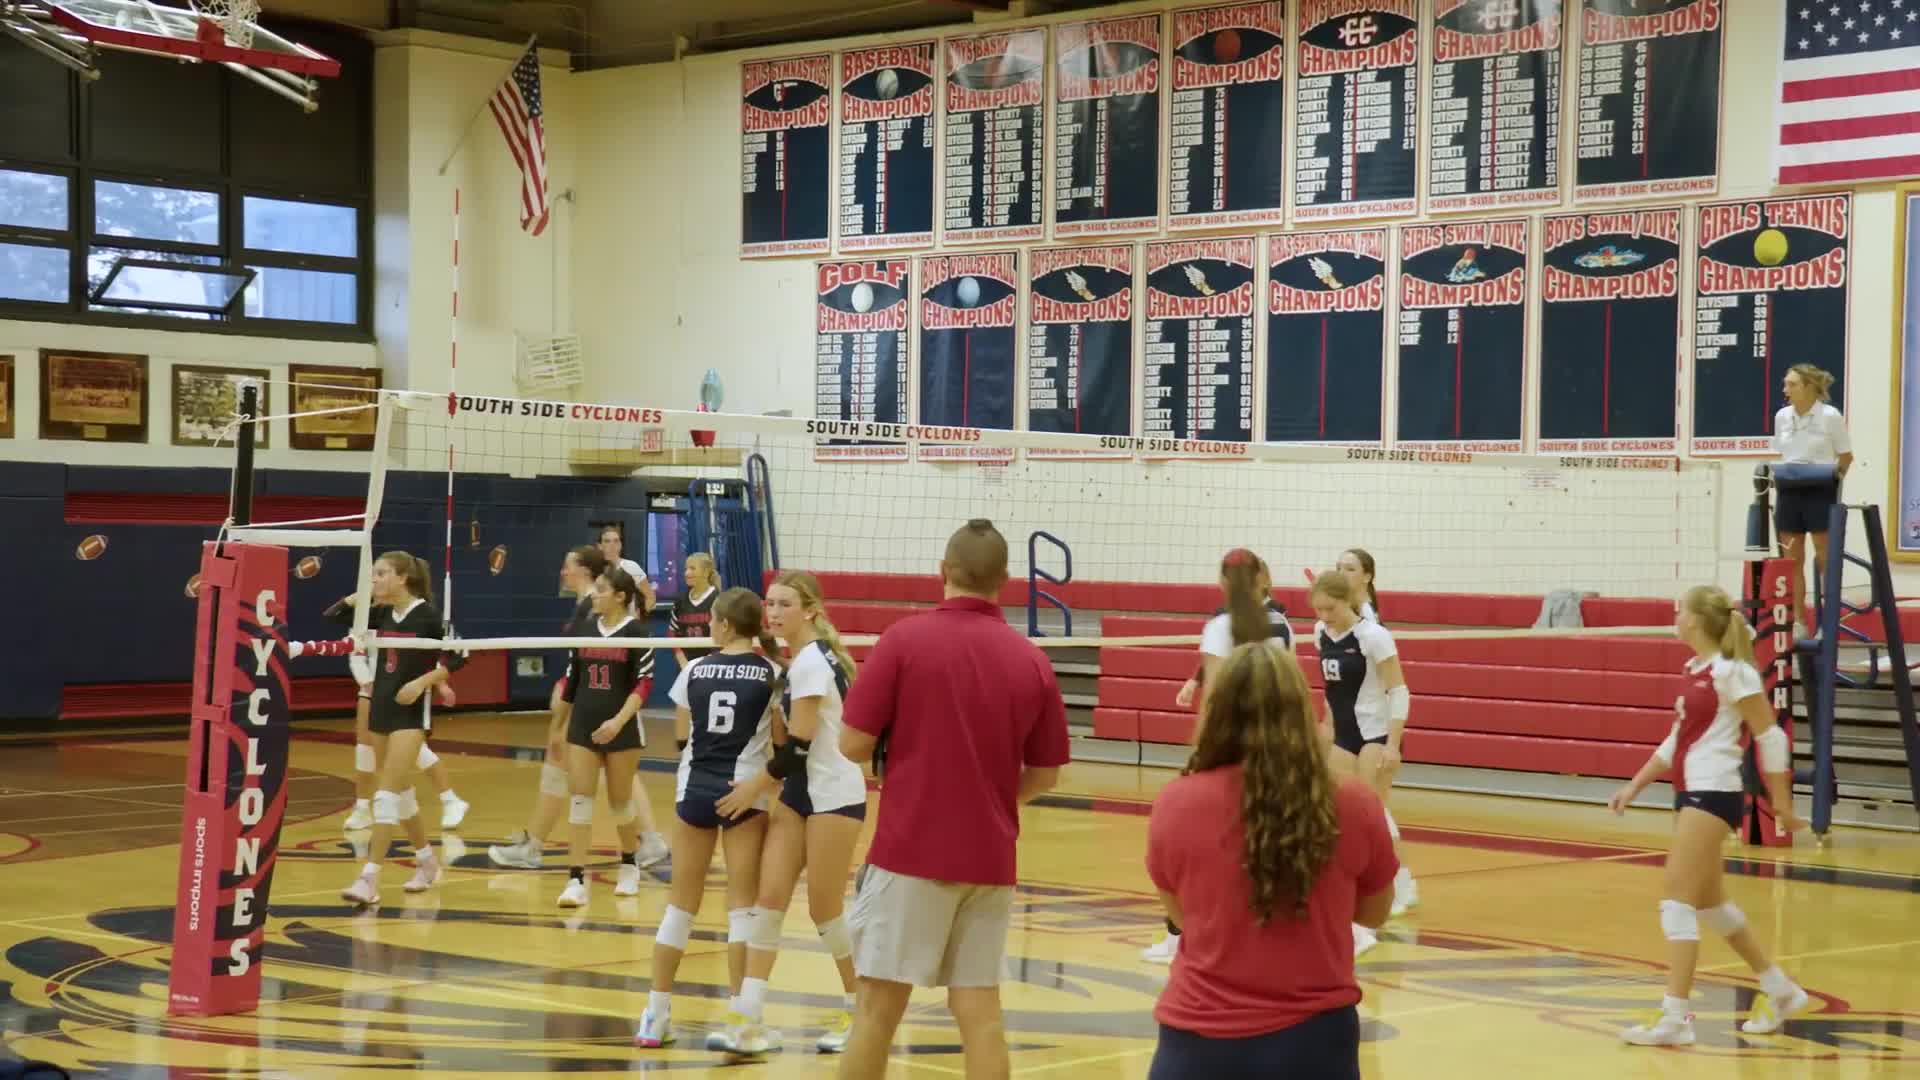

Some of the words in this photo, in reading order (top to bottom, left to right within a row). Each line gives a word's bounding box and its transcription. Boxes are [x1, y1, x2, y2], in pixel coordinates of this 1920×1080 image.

[1207, 1, 1282, 39] BASKETBALL
[1434, 15, 1560, 60] CHAMPIONS
[1583, 1, 1719, 45] CHAMPIONS
[842, 45, 932, 88] BASEBALL
[1173, 44, 1282, 89] CHAMPIONS
[1299, 29, 1416, 76] CHAMPIONS
[946, 78, 1041, 113] CHAMPIONS
[1058, 58, 1159, 100] CHAMPIONS
[743, 95, 829, 132] CHAMPIONS
[842, 83, 932, 123] CHAMPIONS
[1429, 198, 1466, 209] SOUTH
[1470, 195, 1496, 207] SIDE
[1499, 190, 1559, 204] CYCLONES
[1576, 186, 1616, 198] SOUTH
[1619, 184, 1646, 195] SIDE
[1648, 179, 1714, 193] CYCLONES
[1170, 217, 1200, 227] SOUTH
[1204, 215, 1226, 225] SIDE
[1229, 212, 1280, 223] CYCLONES
[1295, 207, 1330, 217] SOUTH
[1333, 205, 1355, 216] SIDE
[1358, 201, 1414, 214] CYCLONES
[1700, 203, 1761, 248] GIRLS
[1765, 198, 1846, 239] TENNIS
[1402, 226, 1441, 260] GIRLS
[1445, 222, 1525, 255] SWIM/DIVE
[1544, 216, 1583, 252] BOYS
[1587, 210, 1679, 245] SWIM/DIVE
[818, 261, 907, 295] GOLF
[921, 258, 948, 294] BOYS
[949, 254, 1016, 288] VOLLEYBALL
[1401, 267, 1524, 309] CHAMPIONS
[1544, 258, 1677, 302] CHAMPIONS
[1699, 248, 1845, 294] CHAMPIONS
[921, 294, 1015, 329] CHAMPIONS
[1031, 287, 1131, 324] CHAMPIONS
[1146, 281, 1253, 320] CHAMPIONS
[1269, 275, 1383, 314] CHAMPIONS
[818, 299, 907, 333] CHAMPIONS
[460, 397, 512, 415] OUTH
[521, 401, 565, 418] SIDE
[571, 405, 662, 423] CYCLONES
[806, 421, 860, 436] SOUTH
[865, 423, 901, 437] SIDE
[906, 426, 981, 441] CYCLONES
[1100, 436, 1145, 451] SOUTH
[1149, 439, 1179, 452] SIDE
[1183, 441, 1246, 455] CYCLONES
[1463, 442, 1520, 453] CYCLONES
[1540, 442, 1577, 451] SOUTH
[1581, 441, 1609, 451] SIDE
[1611, 440, 1675, 451] CYCLONES
[1694, 441, 1736, 450] SOUTH
[1740, 439, 1769, 449] SIDE
[1347, 448, 1384, 461] SOUTH
[1389, 450, 1415, 462] SIDE
[1418, 452, 1472, 463] CYCLONES
[1560, 457, 1593, 467] SOUTH
[1596, 458, 1619, 468] SIDE
[1621, 459, 1669, 469] CYCLONES
[1773, 576, 1788, 709] SOUTH
[587, 663, 612, 689] 11
[692, 664, 737, 680] SOUTH
[738, 664, 768, 682] SIDE
[707, 690, 737, 734] 6
[228, 589, 278, 976] CYCLONES
[194, 817, 207, 867] sports
[188, 869, 205, 931] imports
